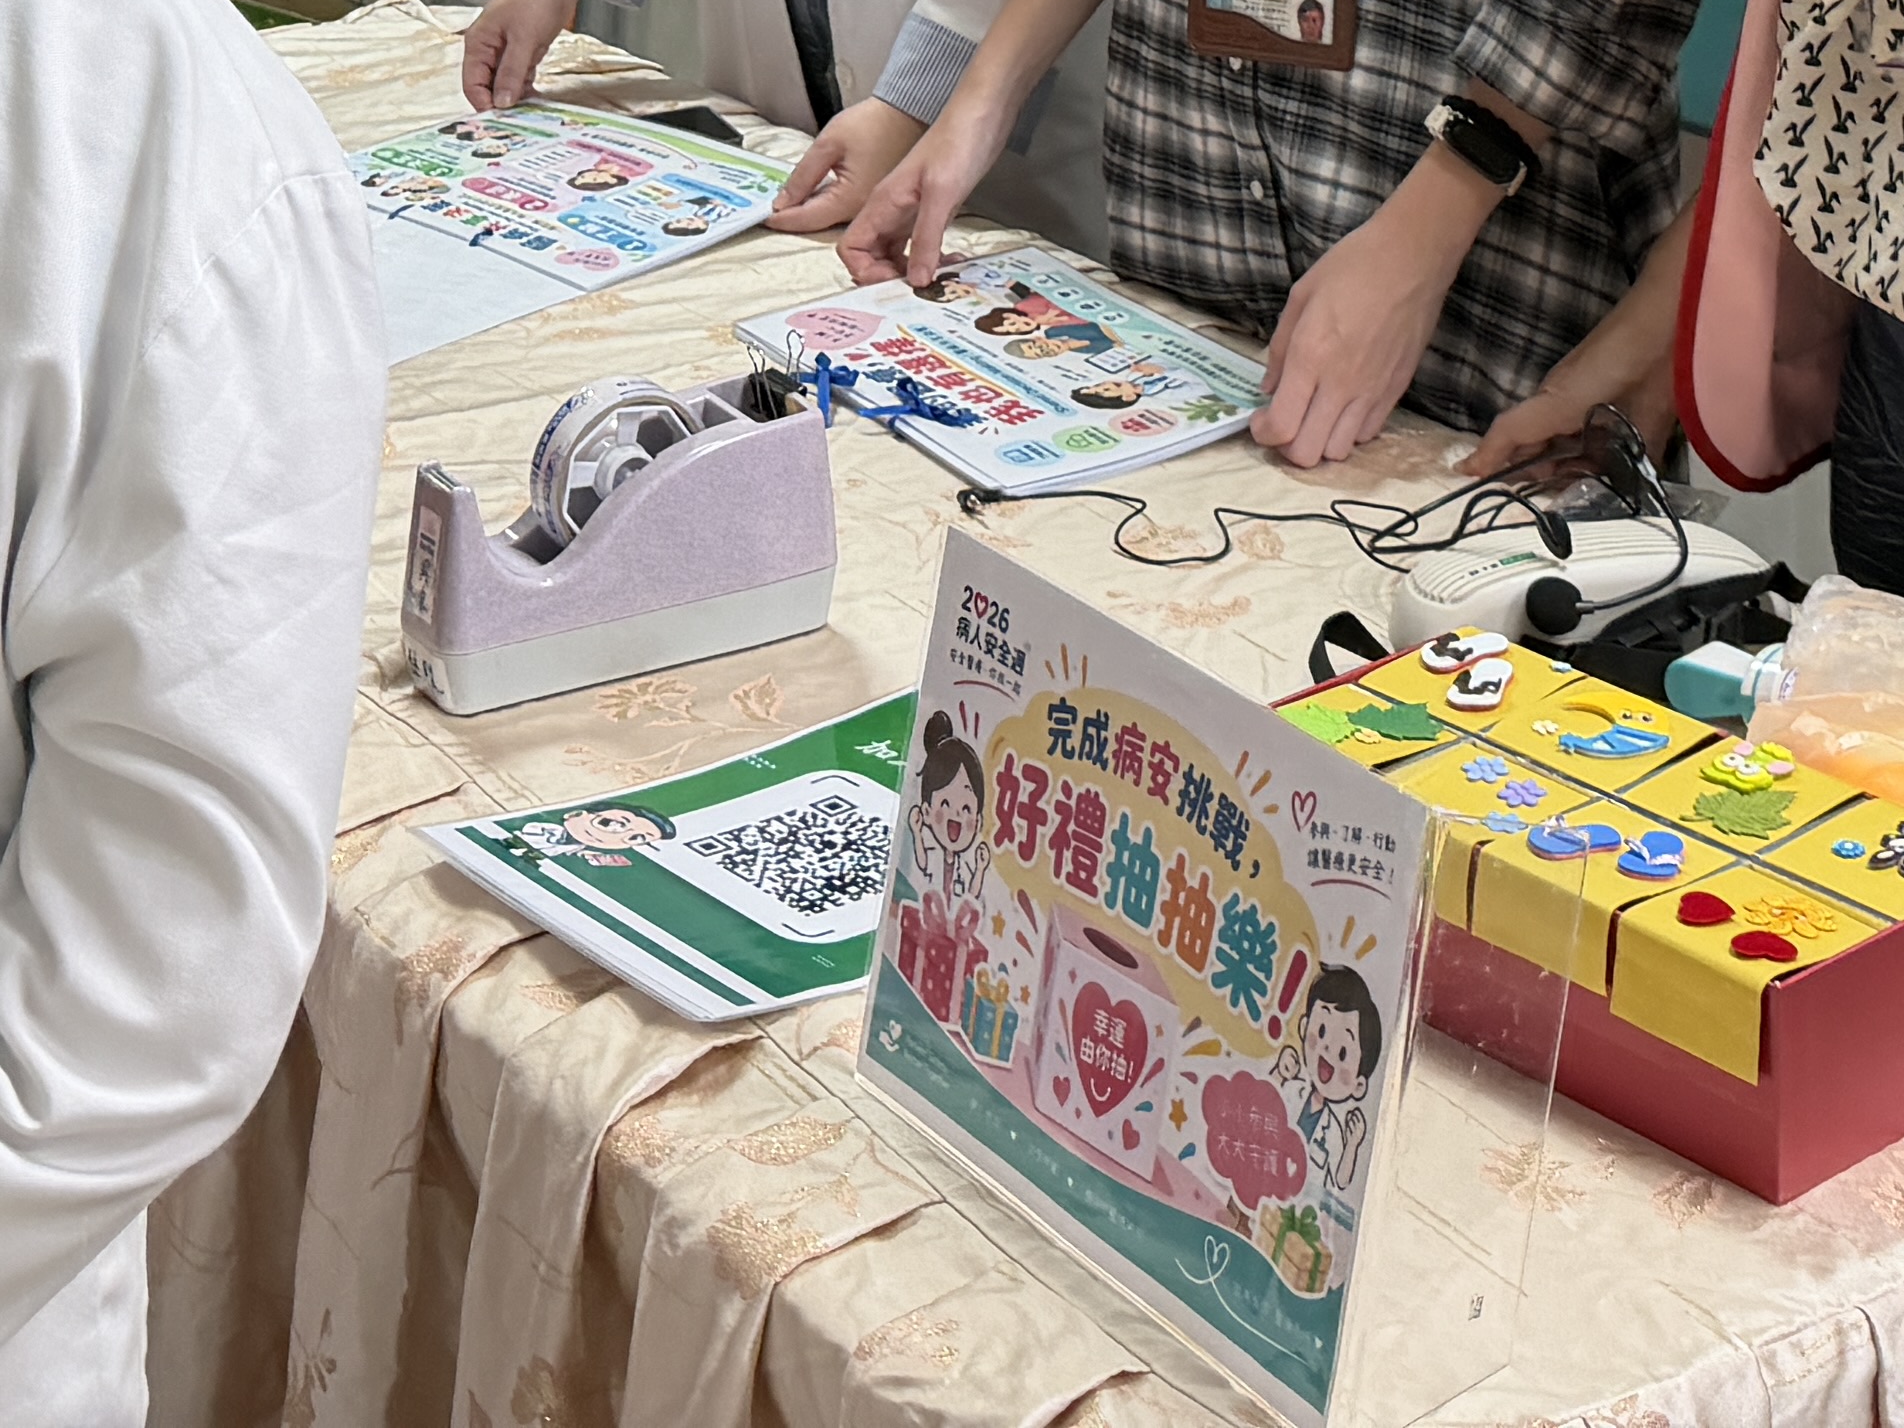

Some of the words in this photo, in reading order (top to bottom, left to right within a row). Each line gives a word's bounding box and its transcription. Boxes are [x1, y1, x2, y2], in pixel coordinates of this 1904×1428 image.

[956, 617, 1026, 676] 病人安全週
[1093, 1010, 1127, 1049] 幸運
